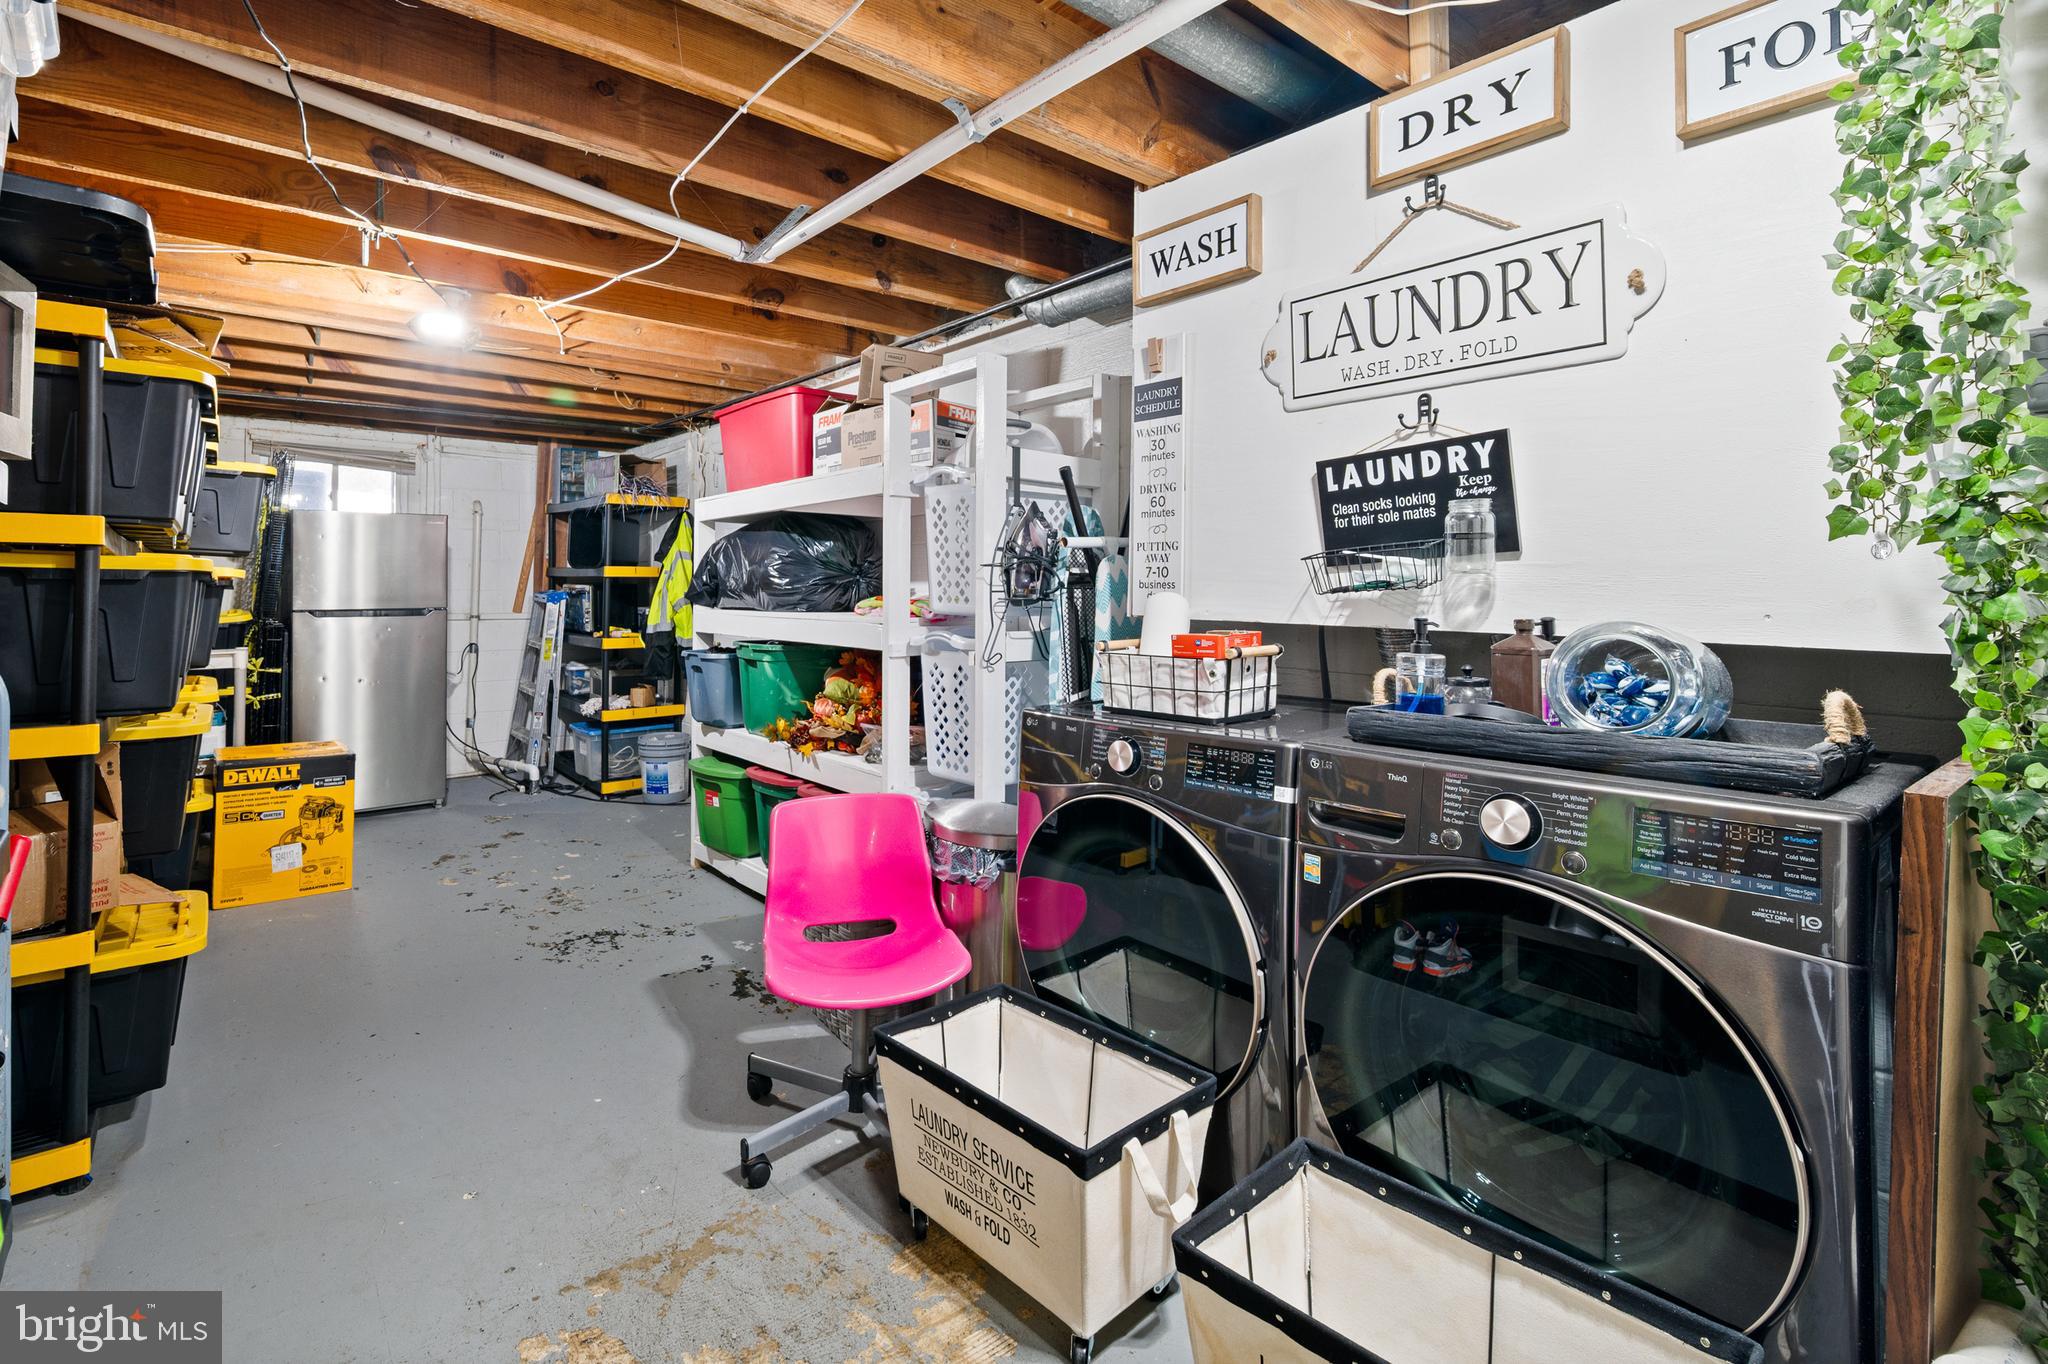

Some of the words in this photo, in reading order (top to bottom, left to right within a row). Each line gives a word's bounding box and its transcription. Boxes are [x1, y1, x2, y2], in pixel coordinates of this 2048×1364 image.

[1718, 6, 1853, 91] FOL
[1397, 68, 1532, 153] DRY
[1149, 223, 1238, 279] WASH
[1298, 239, 1593, 363] LAUNDRY
[1137, 385, 1179, 402] LAUNDRY
[1135, 399, 1181, 416] SCHEDULE
[818, 412, 842, 429] FRAM
[1136, 423, 1181, 438] WASHING
[847, 430, 877, 447] Prestone
[1151, 438, 1166, 452] 30
[1141, 451, 1176, 462] minutes
[1325, 439, 1495, 492] LAUNDRY
[1458, 473, 1492, 488] Keep
[1140, 482, 1177, 495] DRYING
[1455, 487, 1468, 498] the
[1469, 485, 1498, 496] change
[1150, 495, 1166, 508] 60
[1332, 502, 1360, 517] Clean
[1362, 497, 1393, 512] socks
[1395, 492, 1436, 508] looking
[1141, 509, 1176, 518] minutes
[1334, 516, 1349, 529] for
[1351, 512, 1375, 527] their
[1377, 509, 1400, 524] sole
[1402, 506, 1436, 521] mates
[1136, 541, 1179, 552] PUTTING
[1145, 553, 1171, 563] AWAY
[1145, 566, 1169, 578] 7-10
[1139, 580, 1176, 590] business
[1387, 772, 1408, 783] ThinQ
[1445, 784, 1458, 792] Heavy
[1458, 786, 1470, 794] Duty
[1444, 793, 1462, 801] Bedding
[1551, 792, 1569, 801] Bright
[1443, 800, 1462, 808] Sanitary
[1563, 802, 1589, 811] Delicates
[1556, 809, 1571, 817] Perm.
[1573, 812, 1588, 820] Press
[1569, 820, 1588, 829] Towels
[1554, 827, 1571, 836] Speed
[1572, 829, 1588, 838] Wash
[1553, 836, 1587, 847] Downloaded
[1637, 846, 1650, 854] Delay
[1651, 847, 1665, 856] Wash
[1785, 853, 1798, 861] Cold
[1800, 855, 1816, 863] Wash
[1673, 868, 1688, 876] Temp.
[1702, 872, 1714, 880] Spin
[1784, 871, 1800, 879] Extra
[1800, 874, 1816, 882] Rinse
[1756, 882, 1773, 891] Signal
[1751, 910, 1774, 920] DIRECT
[1774, 914, 1795, 924] DRIVE
[1758, 907, 1788, 916] INVERTER
[1800, 914, 1823, 930] 10
[911, 1098, 968, 1151] LAUNDRY
[972, 1137, 1035, 1197] SERVICE
[923, 1135, 987, 1184] NEWBURY
[989, 1178, 999, 1195] &
[1003, 1188, 1026, 1215] CO.
[918, 1146, 1003, 1212] ESTABLISHED
[1006, 1207, 1037, 1241] 1832
[944, 1189, 972, 1221] WASH
[975, 1210, 982, 1227] &
[984, 1216, 1011, 1245] FOLD
